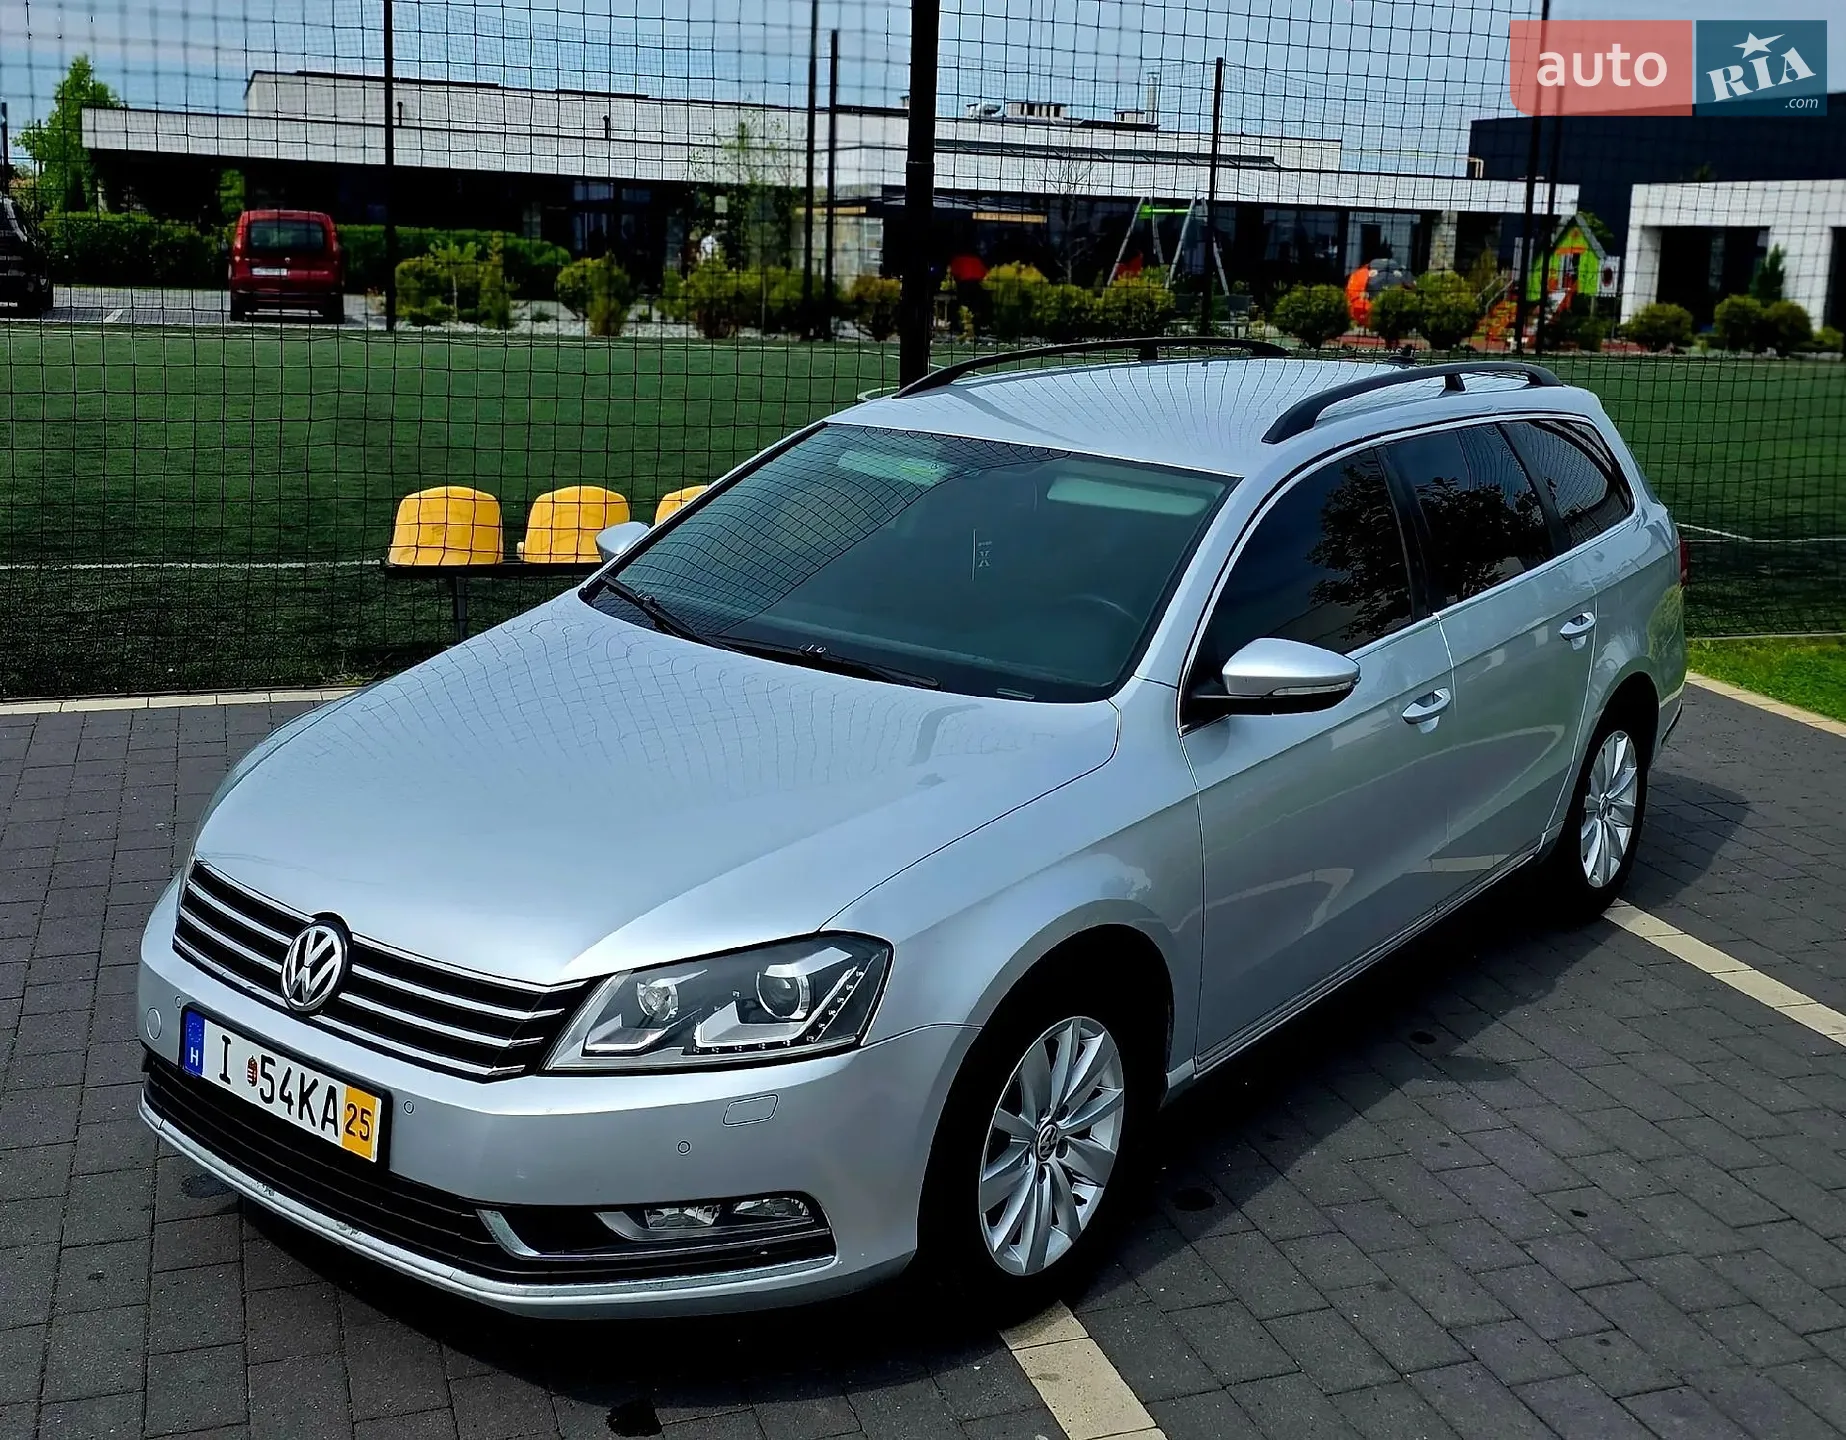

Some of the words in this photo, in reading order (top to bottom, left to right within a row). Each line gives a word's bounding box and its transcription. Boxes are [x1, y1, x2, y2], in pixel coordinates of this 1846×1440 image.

[189, 1046, 200, 1067] H
[259, 1054, 339, 1138] 54KA
[344, 1103, 373, 1142] 25
